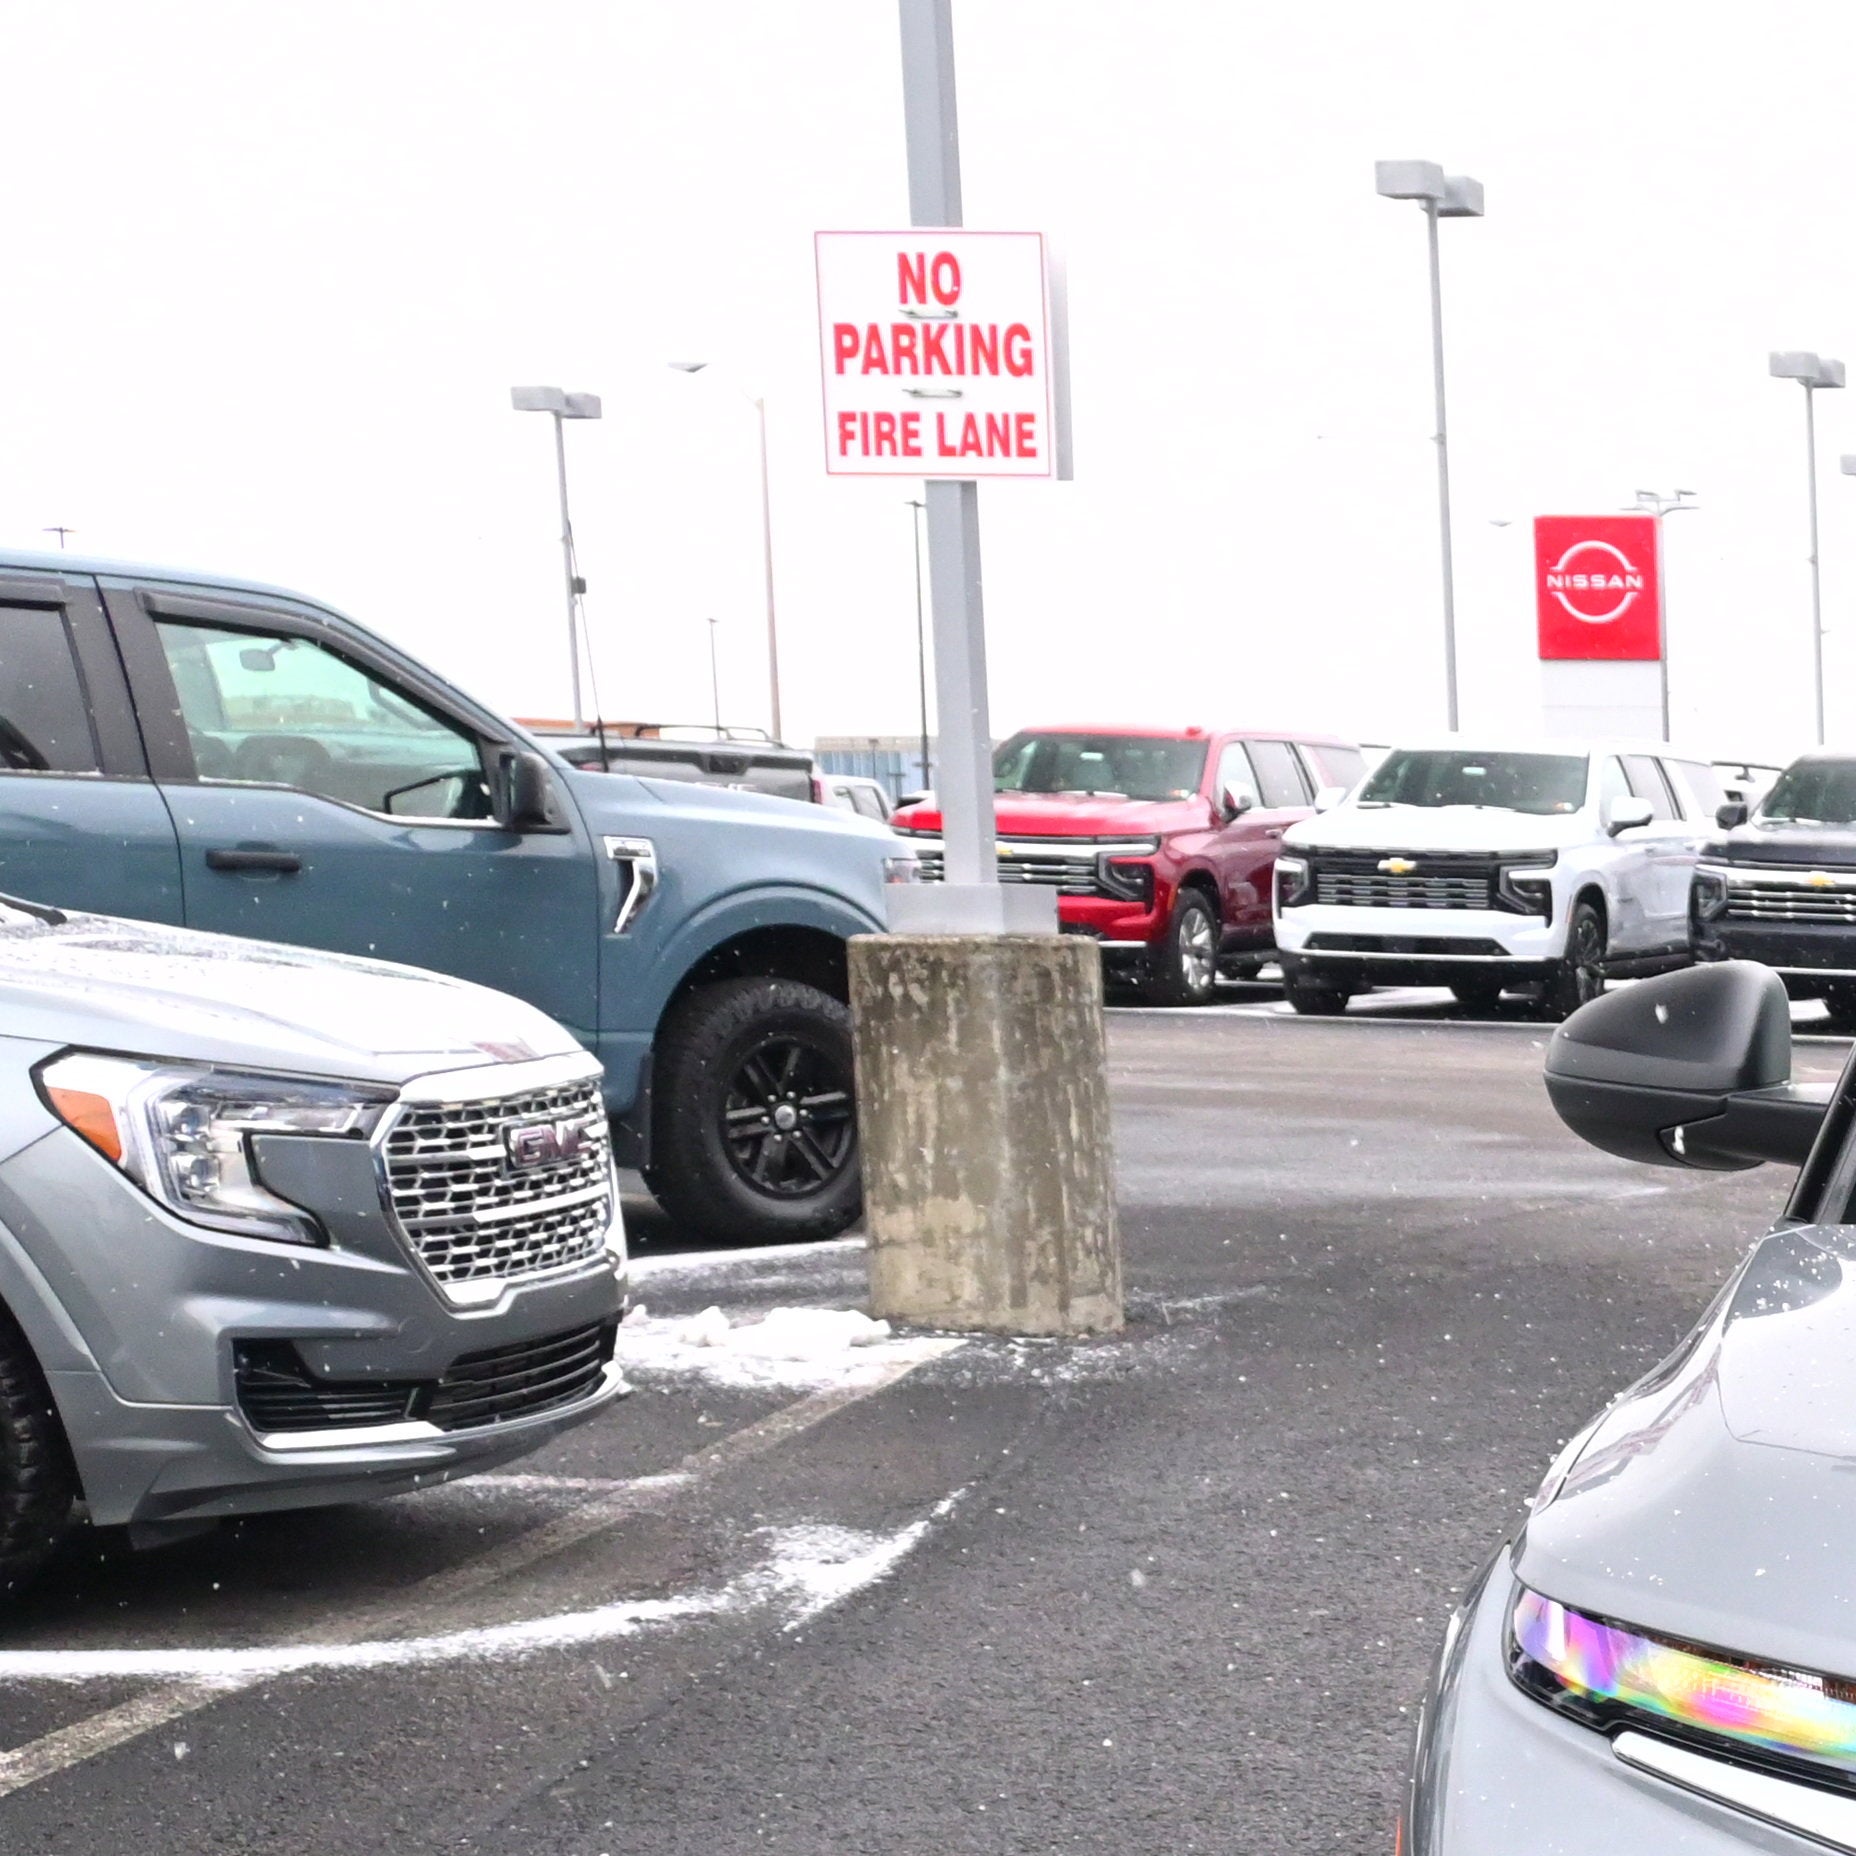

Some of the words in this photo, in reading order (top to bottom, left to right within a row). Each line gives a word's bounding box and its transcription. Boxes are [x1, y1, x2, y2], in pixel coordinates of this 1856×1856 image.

[897, 251, 961, 306] NO
[833, 322, 1034, 377] PARKING
[837, 411, 923, 457] FIRE
[936, 411, 1038, 458] LANE
[1546, 573, 1644, 589] NISSAN
[510, 1119, 595, 1168] GMC
